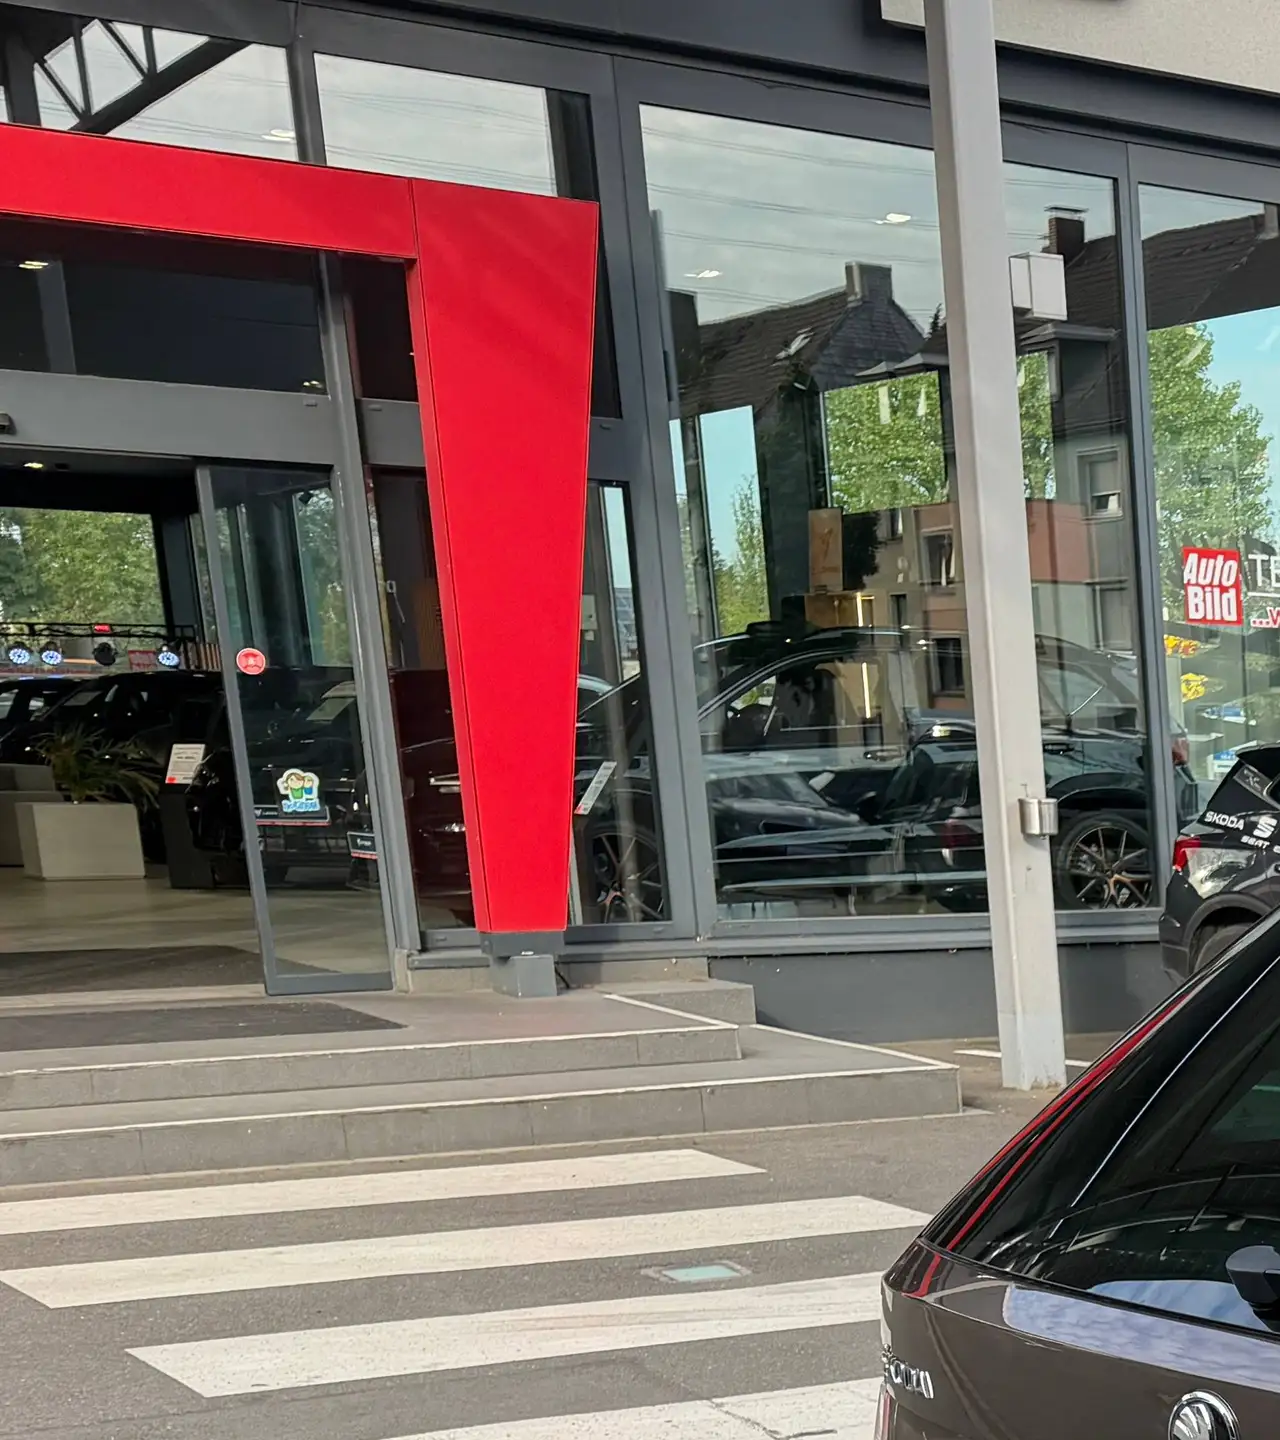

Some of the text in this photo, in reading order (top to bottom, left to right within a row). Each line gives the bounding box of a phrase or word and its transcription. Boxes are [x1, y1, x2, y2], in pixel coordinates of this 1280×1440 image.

[1184, 552, 1239, 586] Auto
[1187, 586, 1238, 622] Bild
[1240, 835, 1270, 849] SEAT
